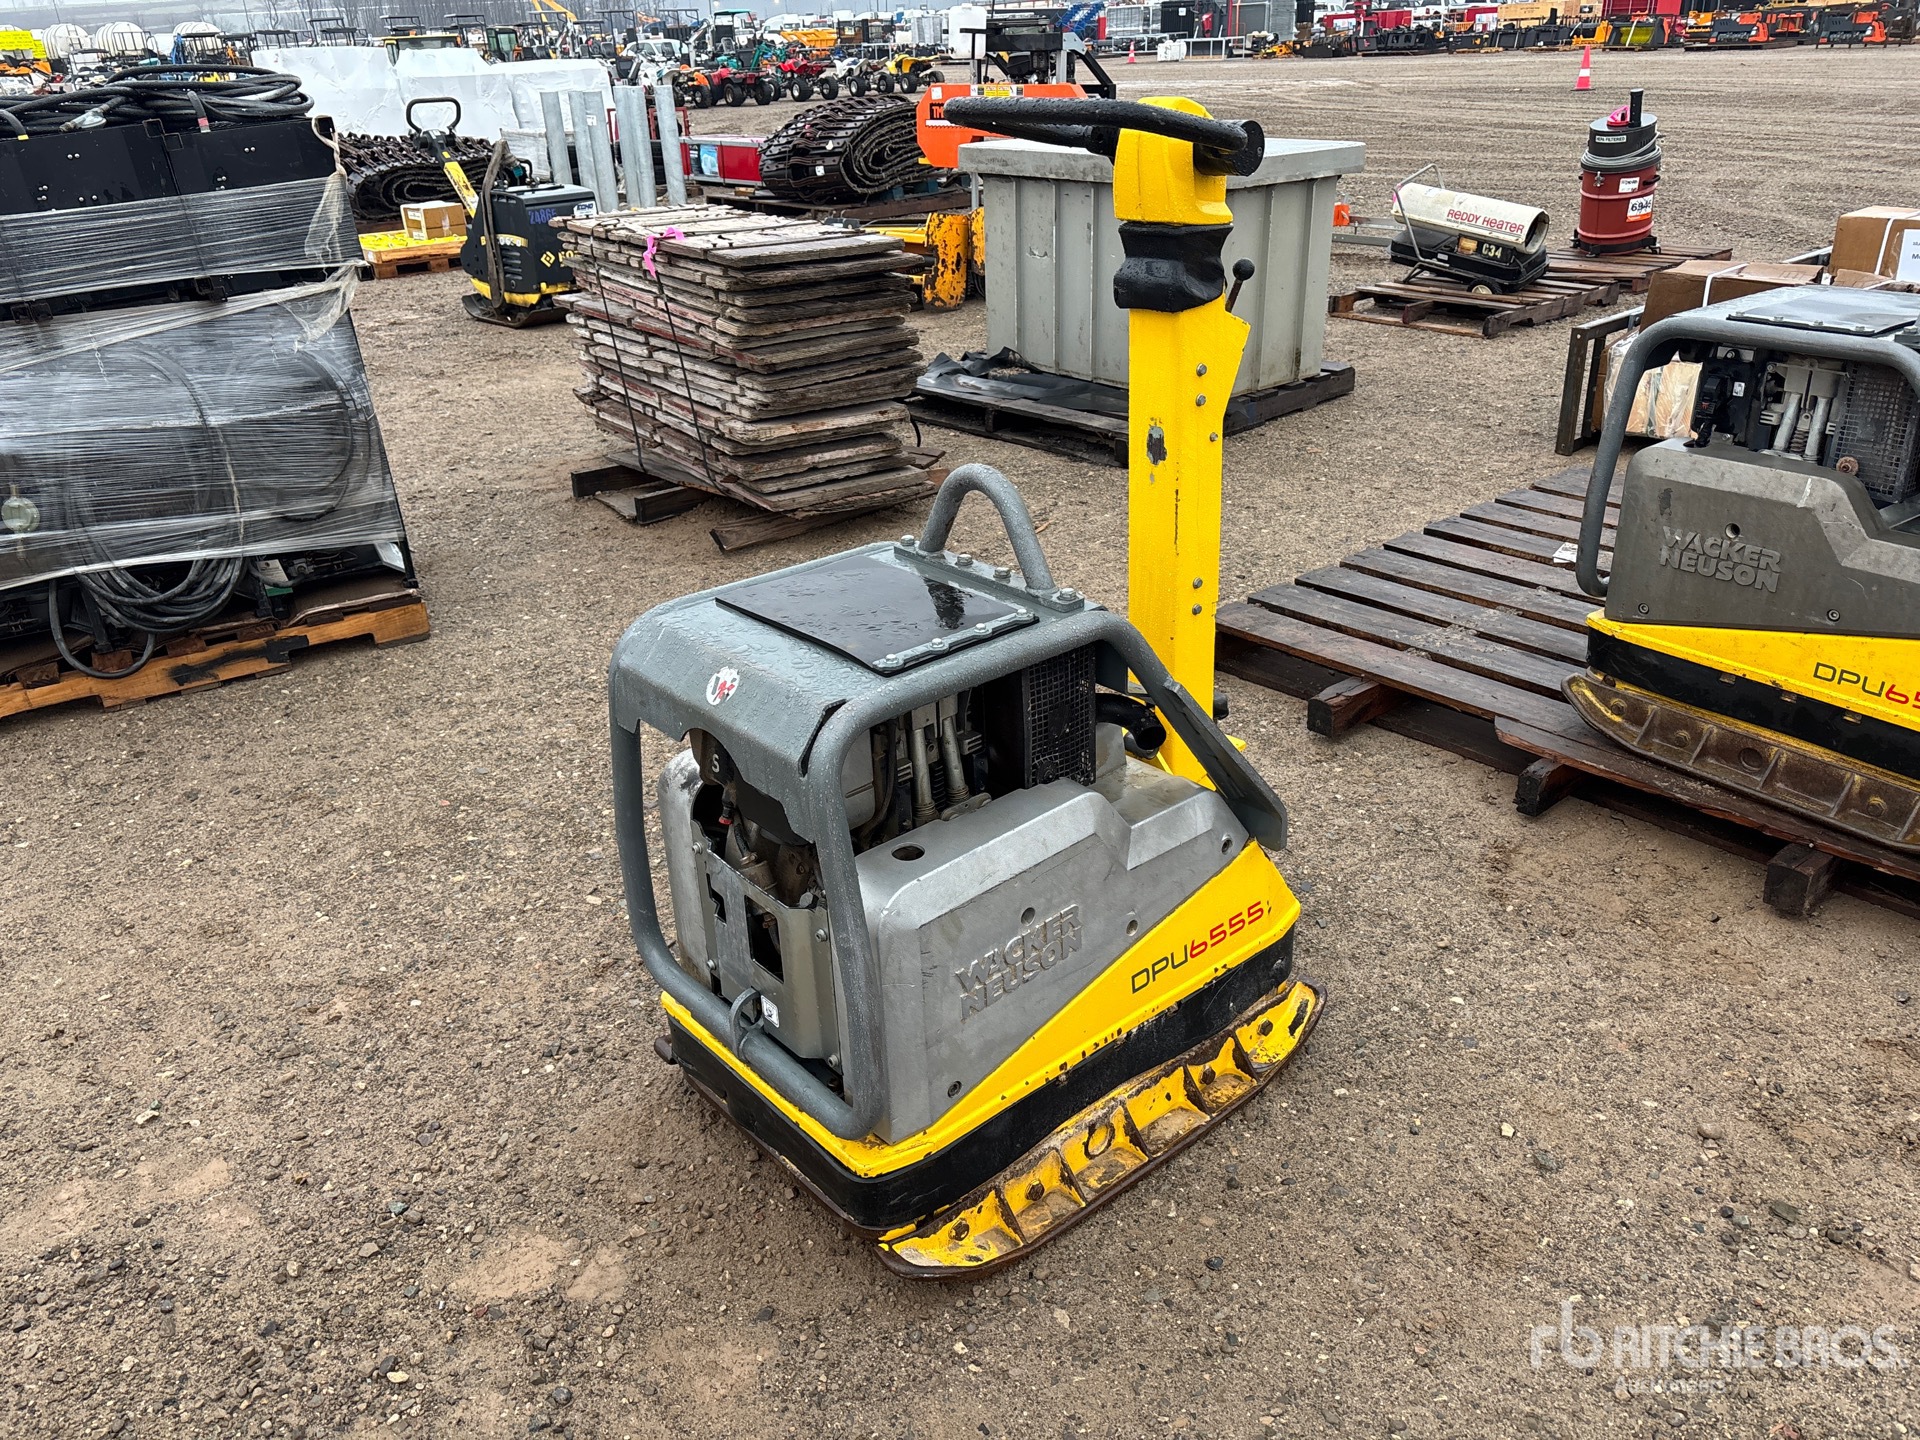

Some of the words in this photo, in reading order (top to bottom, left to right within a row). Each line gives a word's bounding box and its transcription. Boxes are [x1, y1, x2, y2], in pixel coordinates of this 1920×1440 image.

[1481, 242, 1503, 259] C34
[1659, 544, 1781, 593] NEUSON
[1662, 525, 1782, 573] WACKER
[954, 903, 1083, 992] WACKER
[959, 930, 1084, 1024] NEUSON
[1130, 900, 1265, 994] DPU6555
